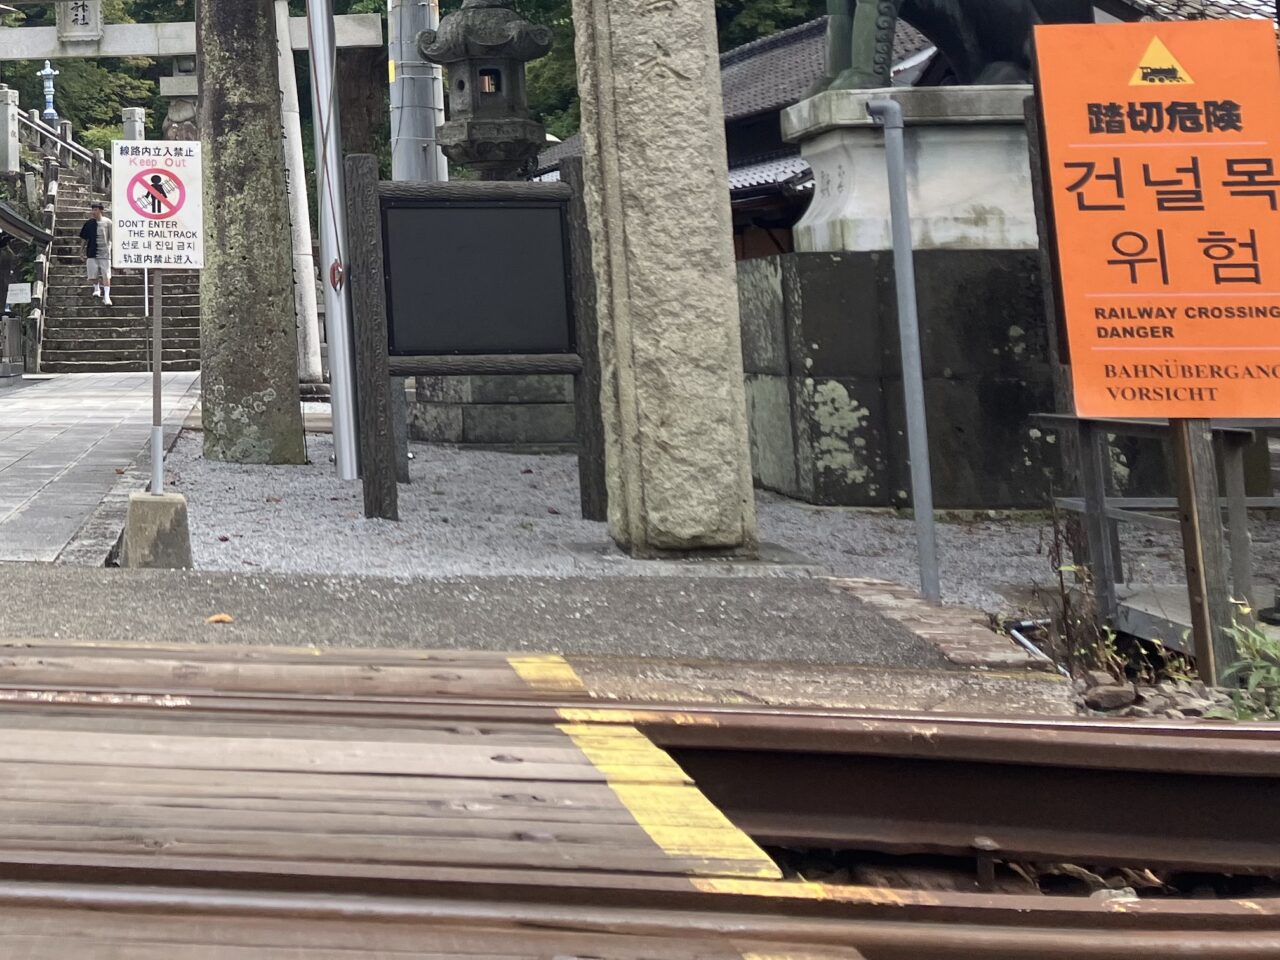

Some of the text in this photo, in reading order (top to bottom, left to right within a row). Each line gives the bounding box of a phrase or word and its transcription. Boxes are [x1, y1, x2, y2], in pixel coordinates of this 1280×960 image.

[1087, 100, 1243, 134] 踏切危険
[120, 146, 194, 158] 線路内立入禁止
[129, 158, 187, 168] Keep Out
[1063, 156, 1280, 212] 건널목
[119, 220, 178, 229] DON'T ENTER
[128, 230, 145, 238] THE
[121, 241, 195, 251] 선로 내 진입 금지
[123, 254, 193, 265] 轨道内禁止进入
[1106, 229, 1263, 286] 위험
[1094, 306, 1280, 320] RAILWAY CROSSING
[1096, 326, 1174, 339] DANGER
[1106, 387, 1218, 402] VORSICHT
